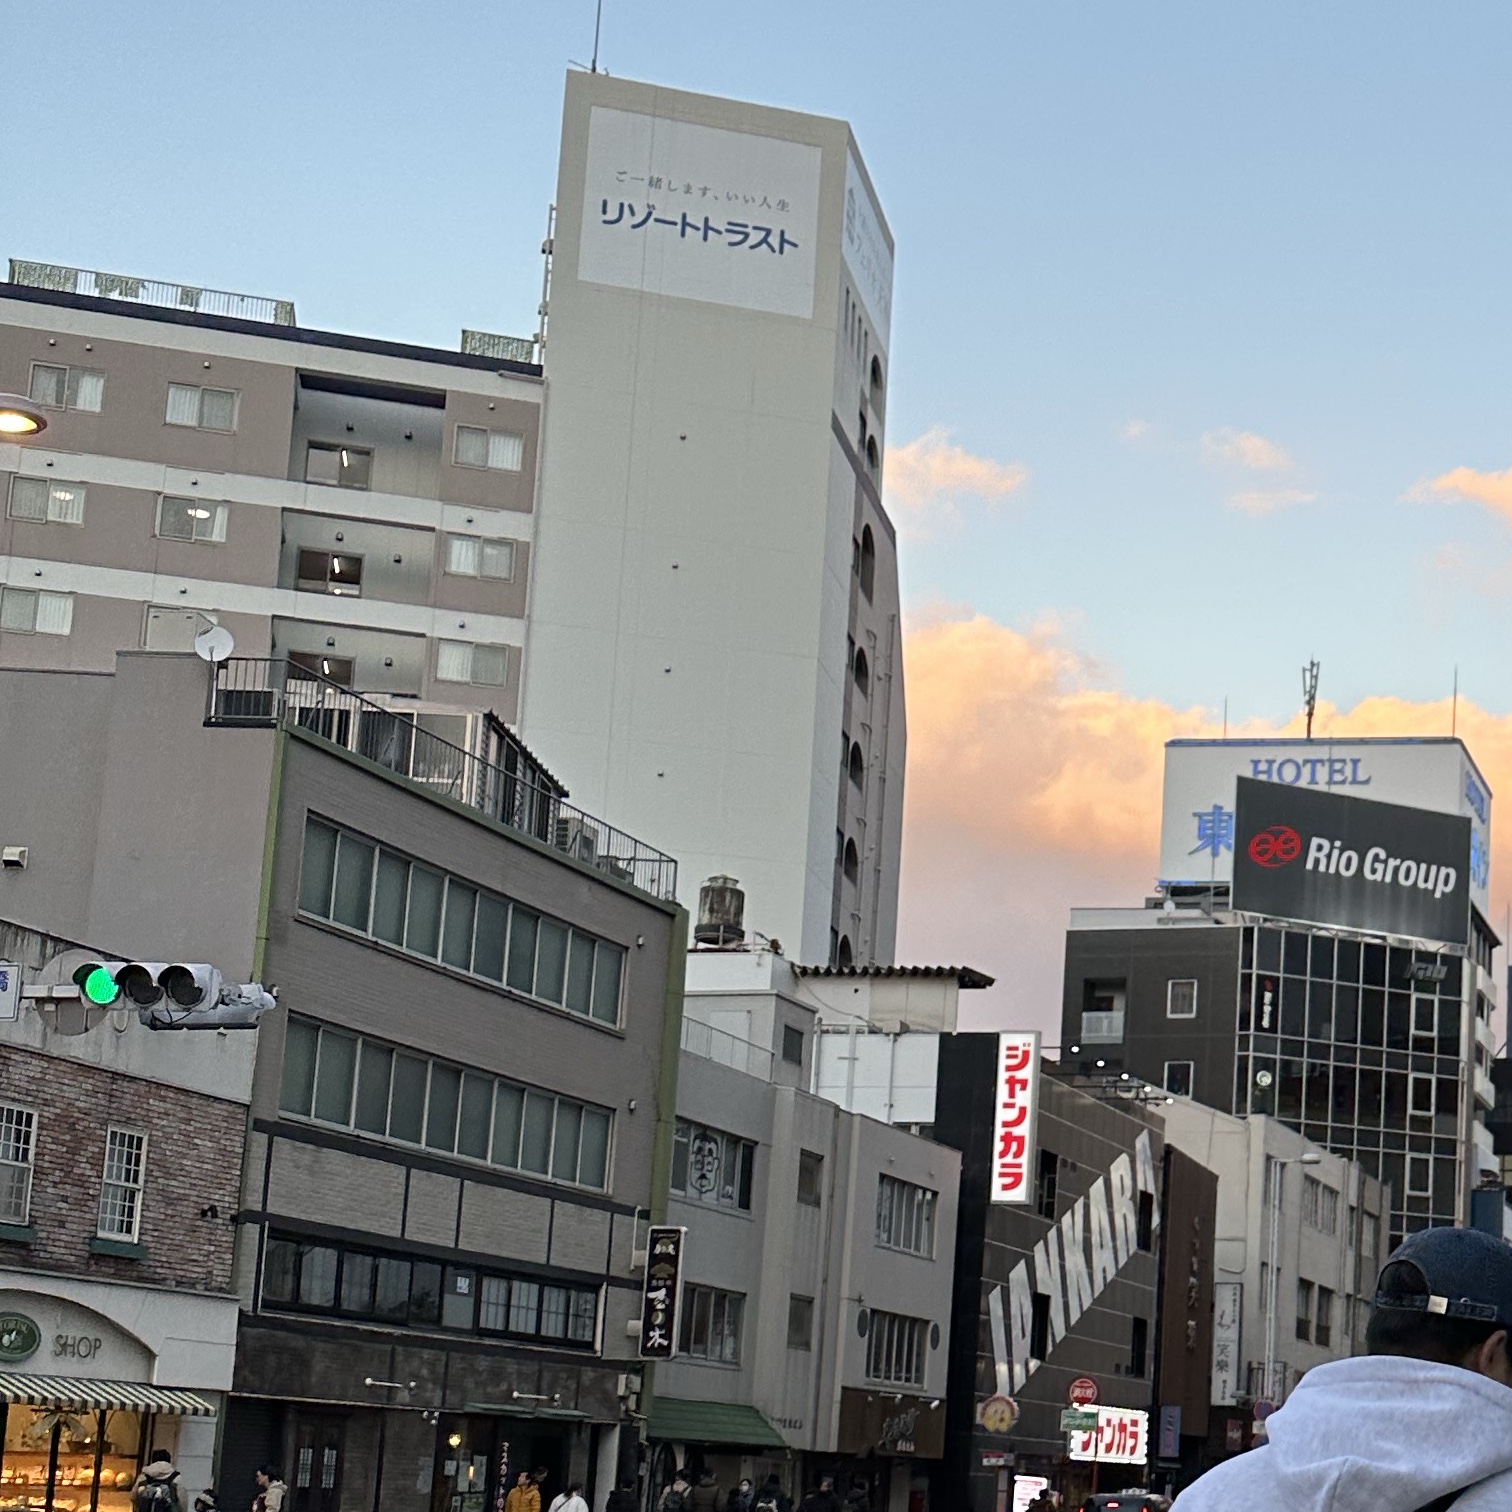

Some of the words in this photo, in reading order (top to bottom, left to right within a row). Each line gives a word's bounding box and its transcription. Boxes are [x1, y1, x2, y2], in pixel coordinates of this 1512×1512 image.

[601, 199, 799, 255] リゾートトラスト
[1250, 758, 1371, 786] HOTEL
[1187, 803, 1234, 858] 東
[1305, 836, 1358, 878] Rio
[1362, 846, 1457, 899] Group
[998, 1042, 1031, 1192] ジャンカラ
[53, 1333, 102, 1359] SHOP
